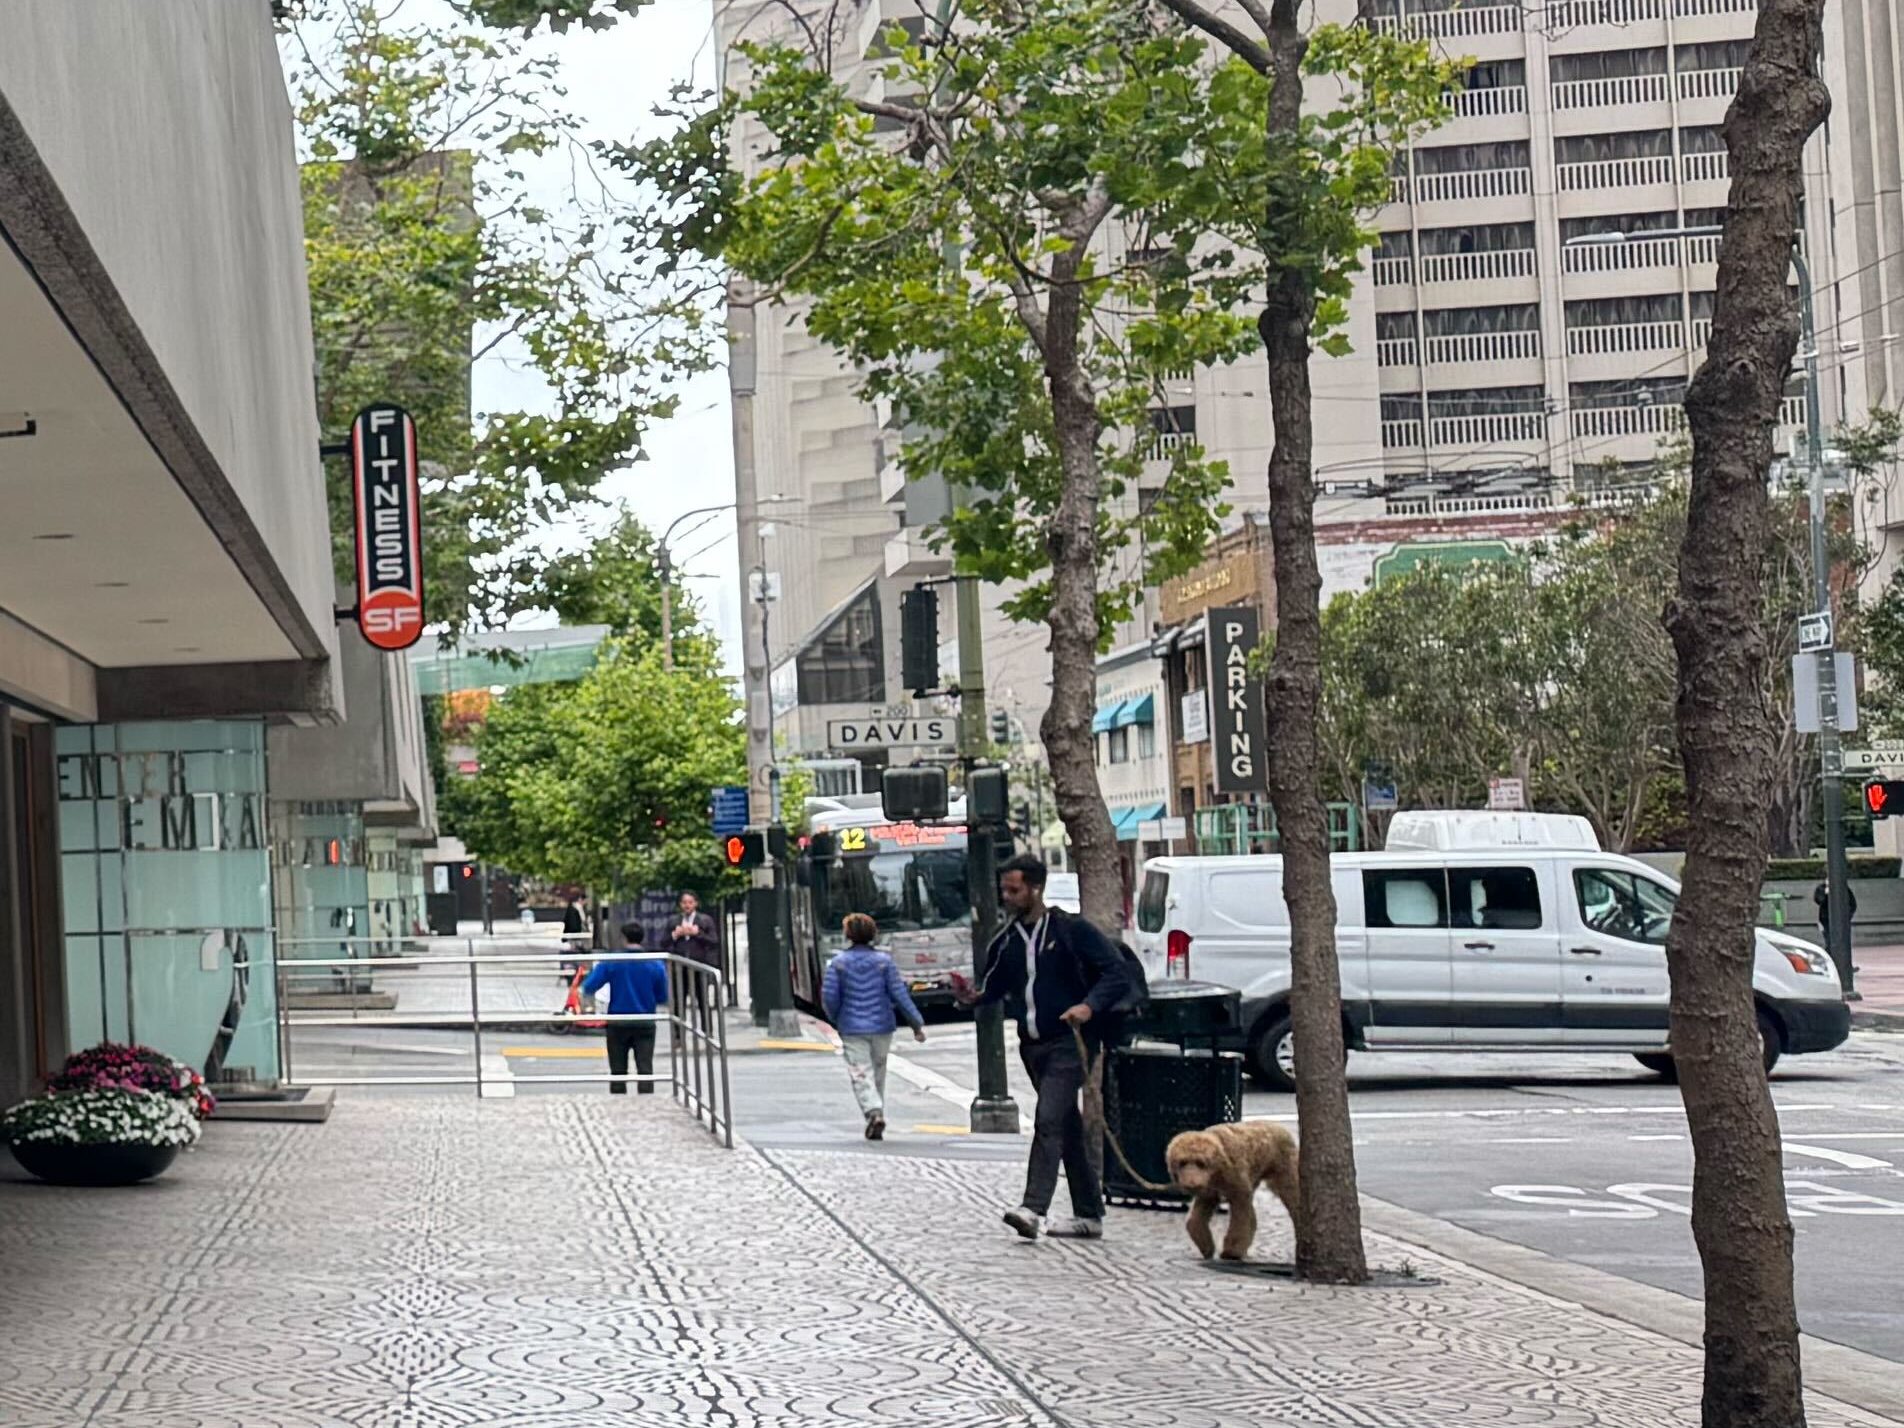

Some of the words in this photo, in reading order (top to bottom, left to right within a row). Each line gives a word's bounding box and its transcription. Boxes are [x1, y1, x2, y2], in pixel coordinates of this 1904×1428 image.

[369, 409, 404, 581] FITNESS
[364, 606, 420, 633] SF
[1225, 622, 1253, 778] PARKING
[841, 722, 944, 743] DAVIS
[840, 827, 866, 851] 12
